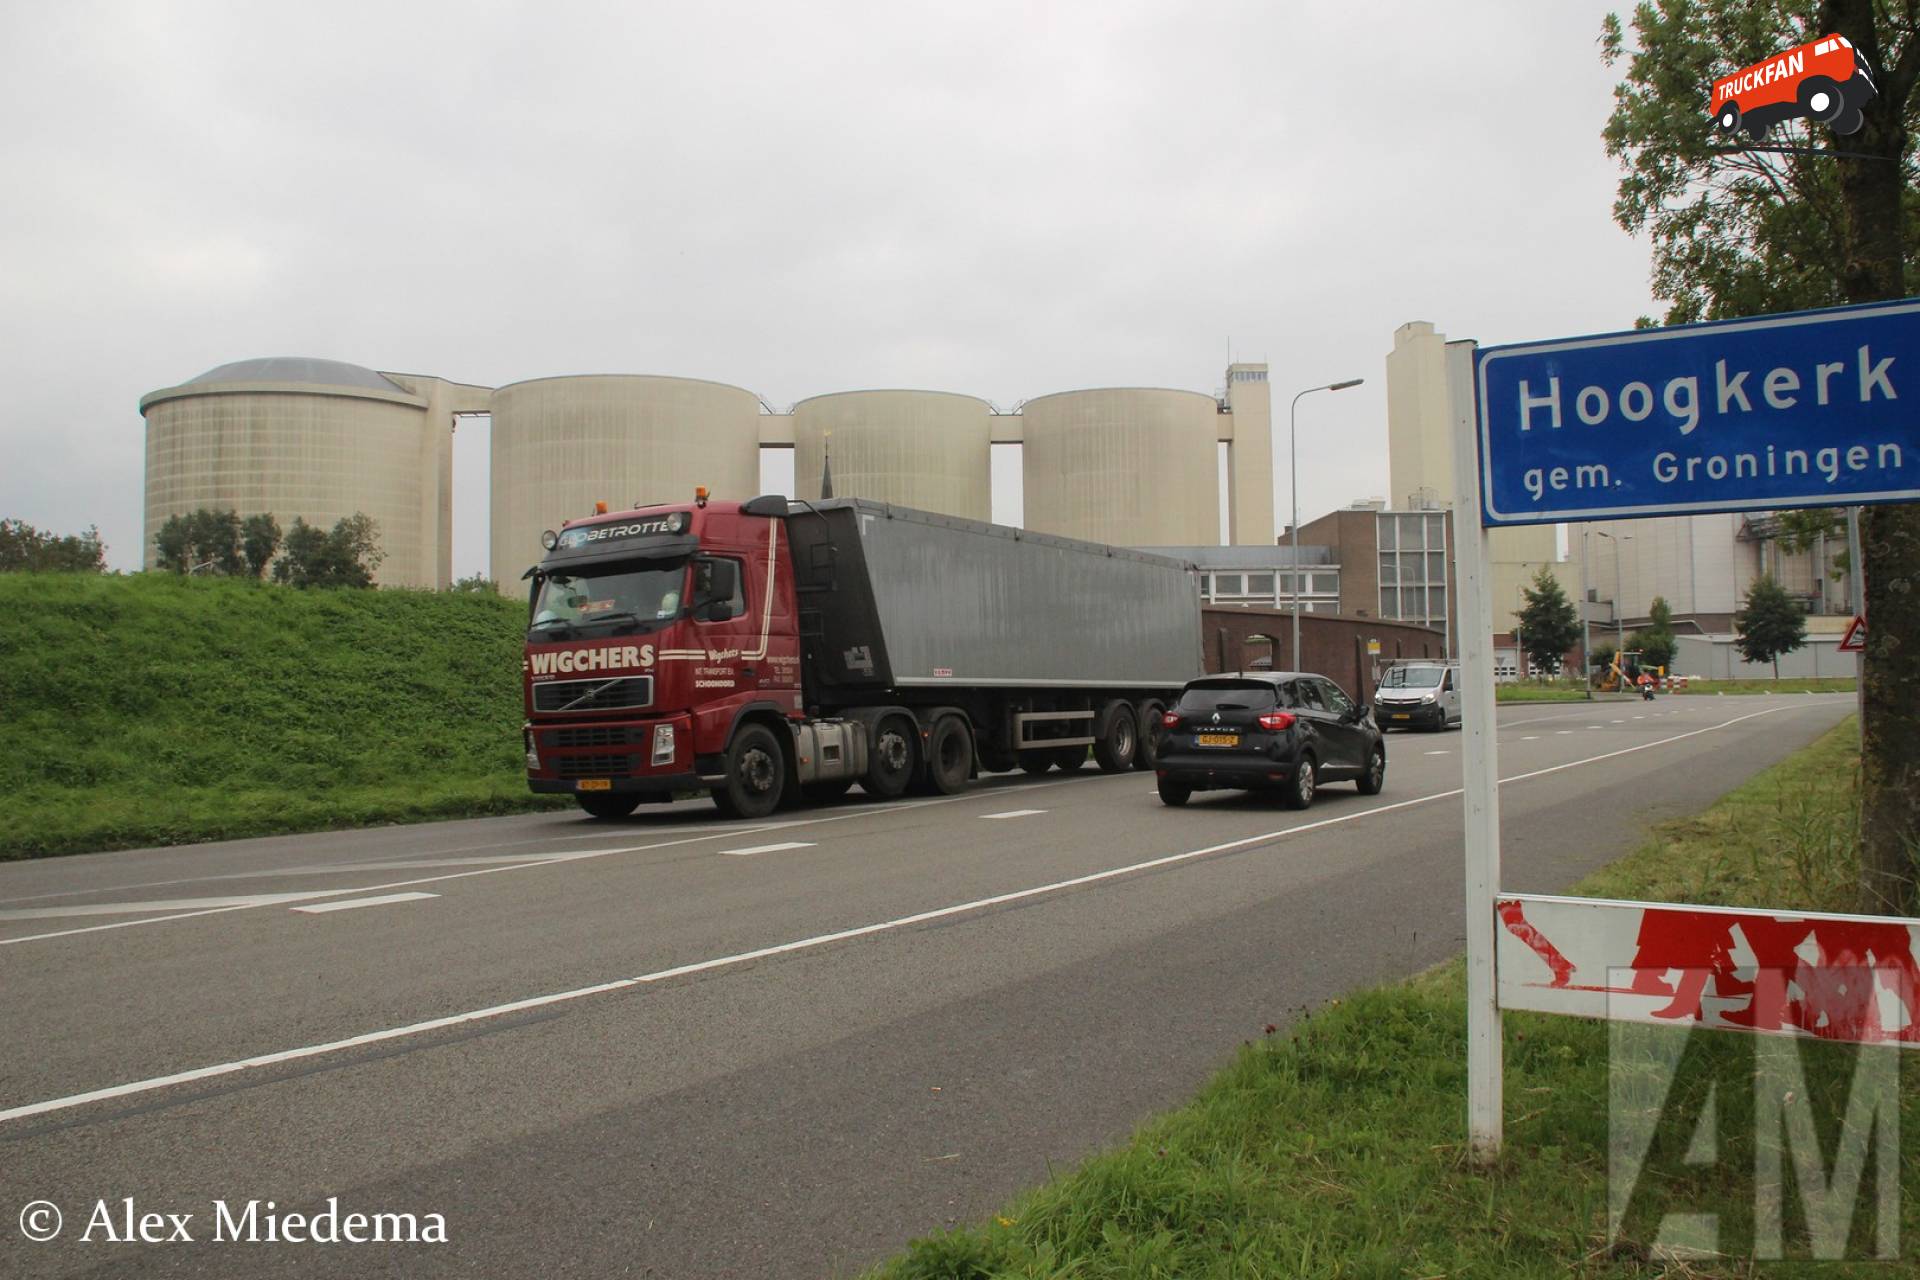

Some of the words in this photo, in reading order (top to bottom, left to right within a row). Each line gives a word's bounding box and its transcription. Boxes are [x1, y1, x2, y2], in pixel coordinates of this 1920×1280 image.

[1518, 344, 1898, 435] Hoogkerk
[1523, 464, 1623, 502] gem.
[1652, 442, 1903, 484] Groningen
[558, 519, 669, 547] GLOBETROTTE
[530, 644, 655, 675] WIGCHERS
